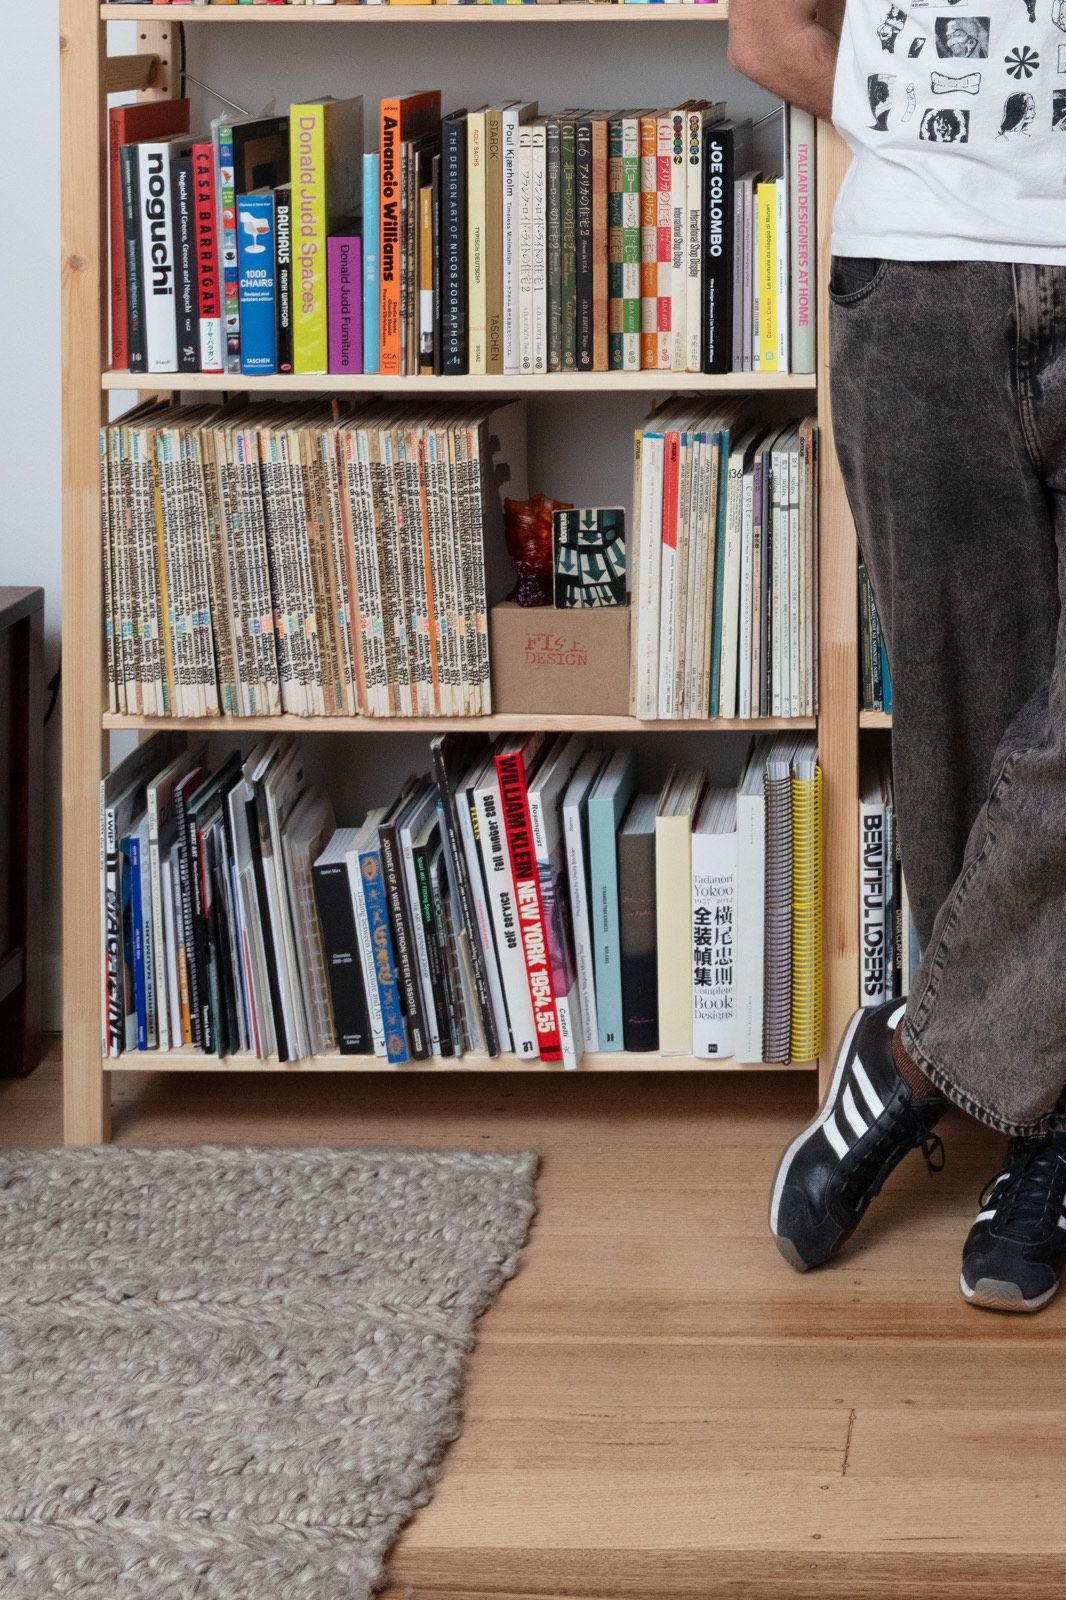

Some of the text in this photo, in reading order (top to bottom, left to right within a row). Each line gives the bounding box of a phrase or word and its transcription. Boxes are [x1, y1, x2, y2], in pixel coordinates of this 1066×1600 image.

[506, 124, 515, 146] Poul
[179, 171, 188, 200] Noguchi
[506, 149, 515, 197] Kjærholm
[298, 117, 317, 313] Donald Judd Spaces
[383, 116, 398, 282] Amancio Williams
[579, 163, 590, 236] アメリカの住宅2
[710, 141, 723, 256] JOE COLOMBO
[145, 153, 172, 295] noguchi
[181, 215, 189, 242] Greece,
[197, 153, 215, 315] CASA BARRAGAN
[277, 206, 289, 264] BAUHAUS
[450, 226, 457, 239] OF
[490, 120, 499, 361] STARCK TASCHEN
[688, 209, 700, 278] International Shop Display
[797, 144, 809, 326] ITALIAN DESIGNERS AT HOME
[182, 244, 190, 269] Greece
[245, 270, 267, 278] 1000
[182, 284, 192, 312] Noguchi
[240, 279, 273, 287] CHAIRS
[281, 291, 289, 328] WHITFORD
[340, 245, 351, 366] Donald Judd Furniture
[450, 282, 458, 353] ZOGRAPHOS
[345, 432, 353, 460] domus
[349, 489, 356, 497] di
[350, 498, 359, 544] architettura
[361, 630, 370, 670] settembre
[531, 804, 543, 847] Rosenquist
[384, 838, 394, 872] JOURNEY
[389, 874, 396, 884] OF
[498, 756, 556, 1033] WILLIAM KLEIN NEW YORK 1954.55
[694, 885, 734, 896] Yokoo
[392, 892, 400, 912] WISE
[864, 814, 883, 996] BEAUTIFUL LOSERS
[395, 914, 411, 977] ELECTRON/PETER
[714, 906, 734, 986] 横尾忠則
[404, 979, 417, 1015] LYSSIOTIS
[694, 995, 734, 1009] Book
[559, 1008, 569, 1038] Castelli
